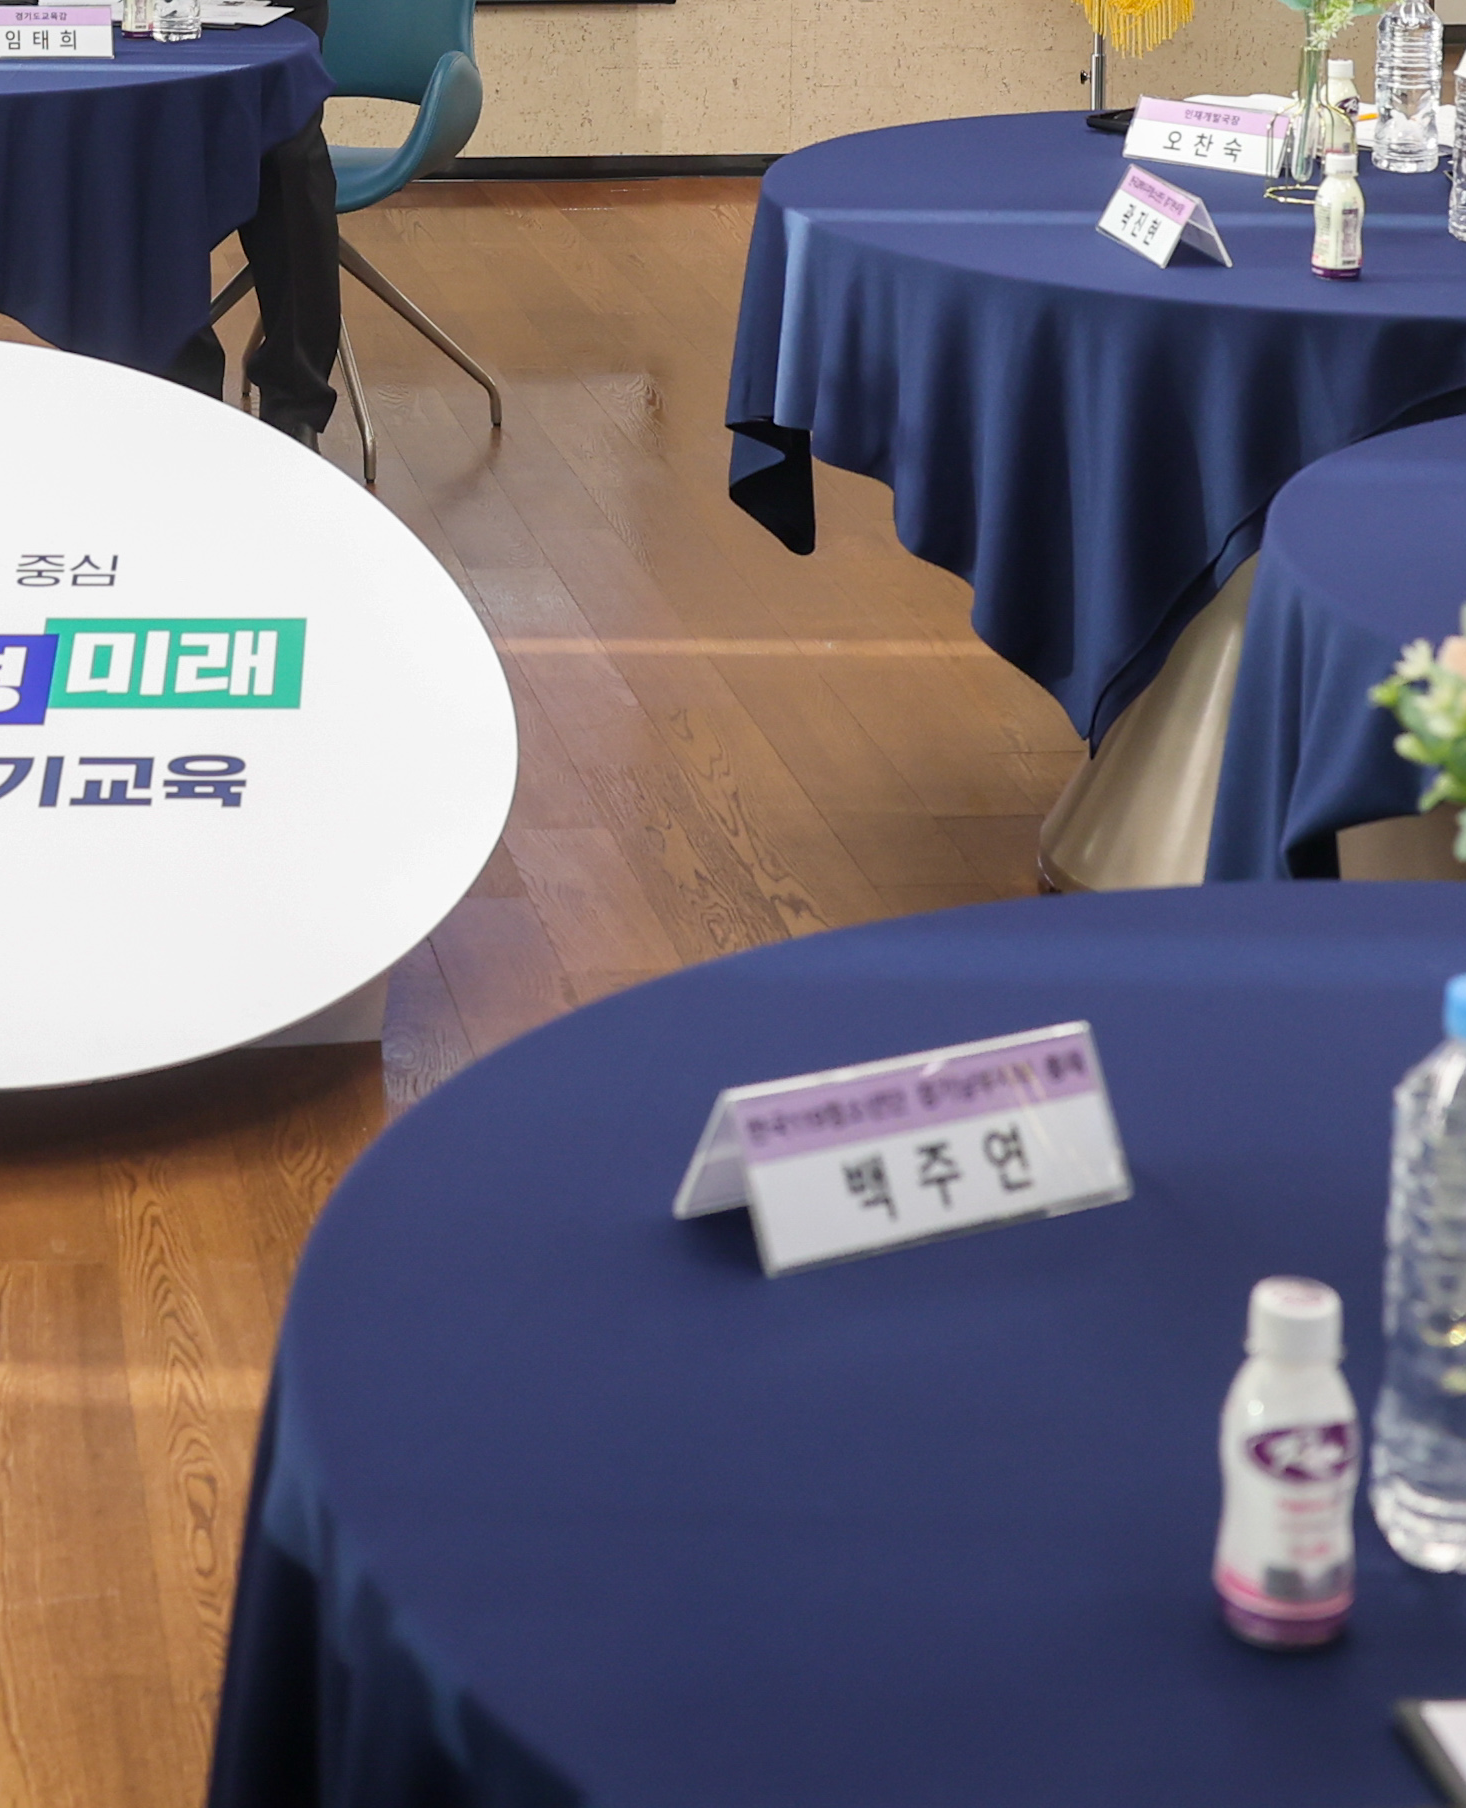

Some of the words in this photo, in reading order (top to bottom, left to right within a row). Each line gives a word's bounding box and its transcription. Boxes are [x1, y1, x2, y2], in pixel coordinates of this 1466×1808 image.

[15, 12, 68, 21] 경기도교육감
[1184, 108, 1240, 125] 인재개발국장
[15, 554, 119, 587] 중심
[65, 629, 278, 696] 미래
